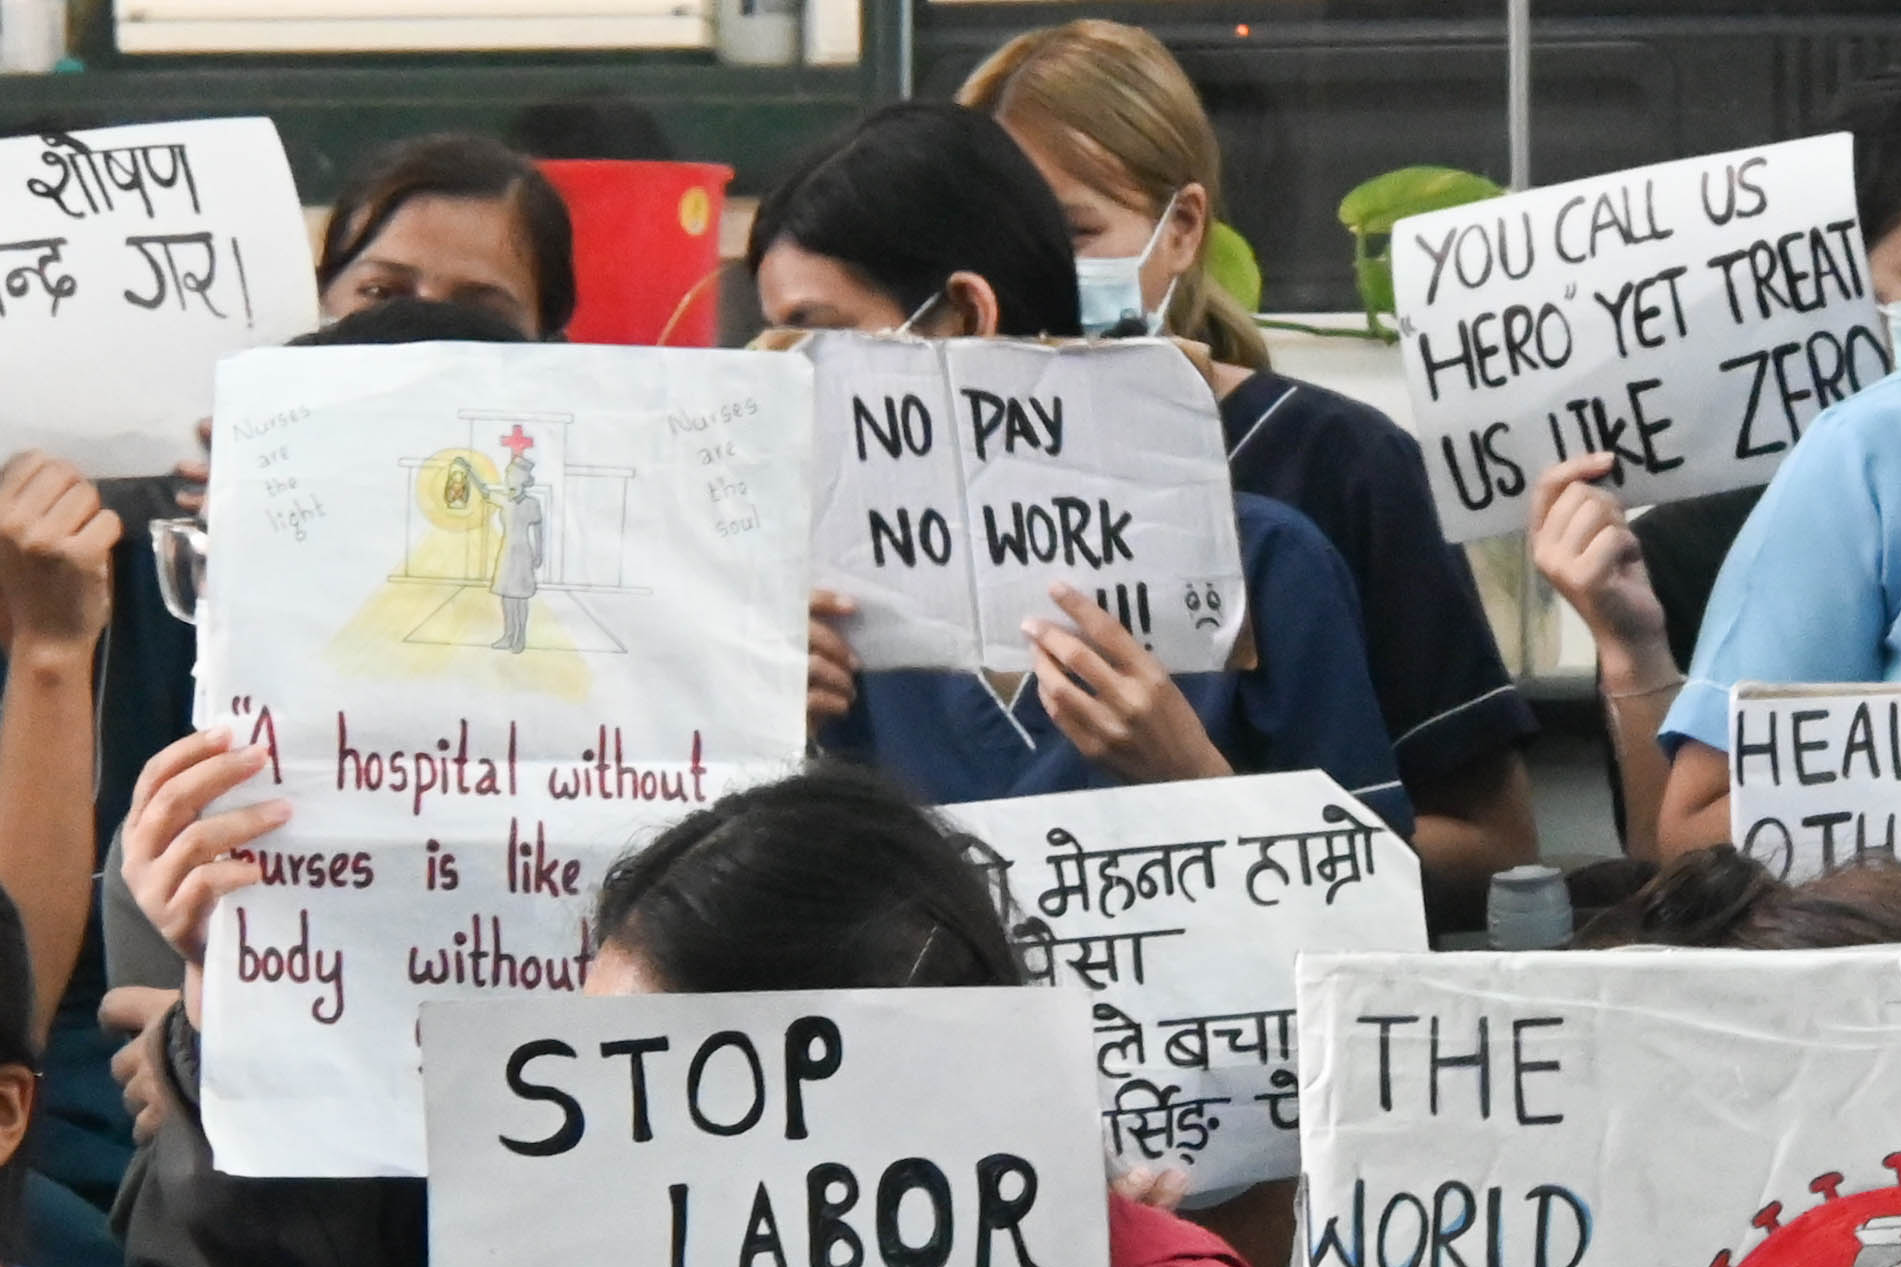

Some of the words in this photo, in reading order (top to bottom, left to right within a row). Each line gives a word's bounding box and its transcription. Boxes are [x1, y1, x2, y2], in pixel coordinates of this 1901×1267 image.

[27, 134, 201, 219] शोषण
[1415, 212, 1534, 306] YOU
[1555, 180, 1674, 264] CALL
[1702, 157, 1768, 226] US
[1594, 266, 1688, 359] YET
[1707, 220, 1864, 325] TREAT
[668, 397, 758, 434] Nurses
[698, 440, 736, 466] are
[853, 394, 932, 461] NO
[961, 388, 1063, 461] PAY
[1442, 422, 1526, 511] US
[1720, 325, 1891, 460] ZERO
[868, 508, 952, 568] NO
[983, 496, 1133, 570] WORK
[336, 711, 517, 815] hospital
[547, 724, 707, 802] without
[426, 839, 459, 891] is
[507, 817, 581, 896] like
[237, 907, 345, 1025] body
[408, 913, 594, 990] without
[500, 1015, 843, 1157] STOP
[1356, 1014, 1564, 1126] THE
